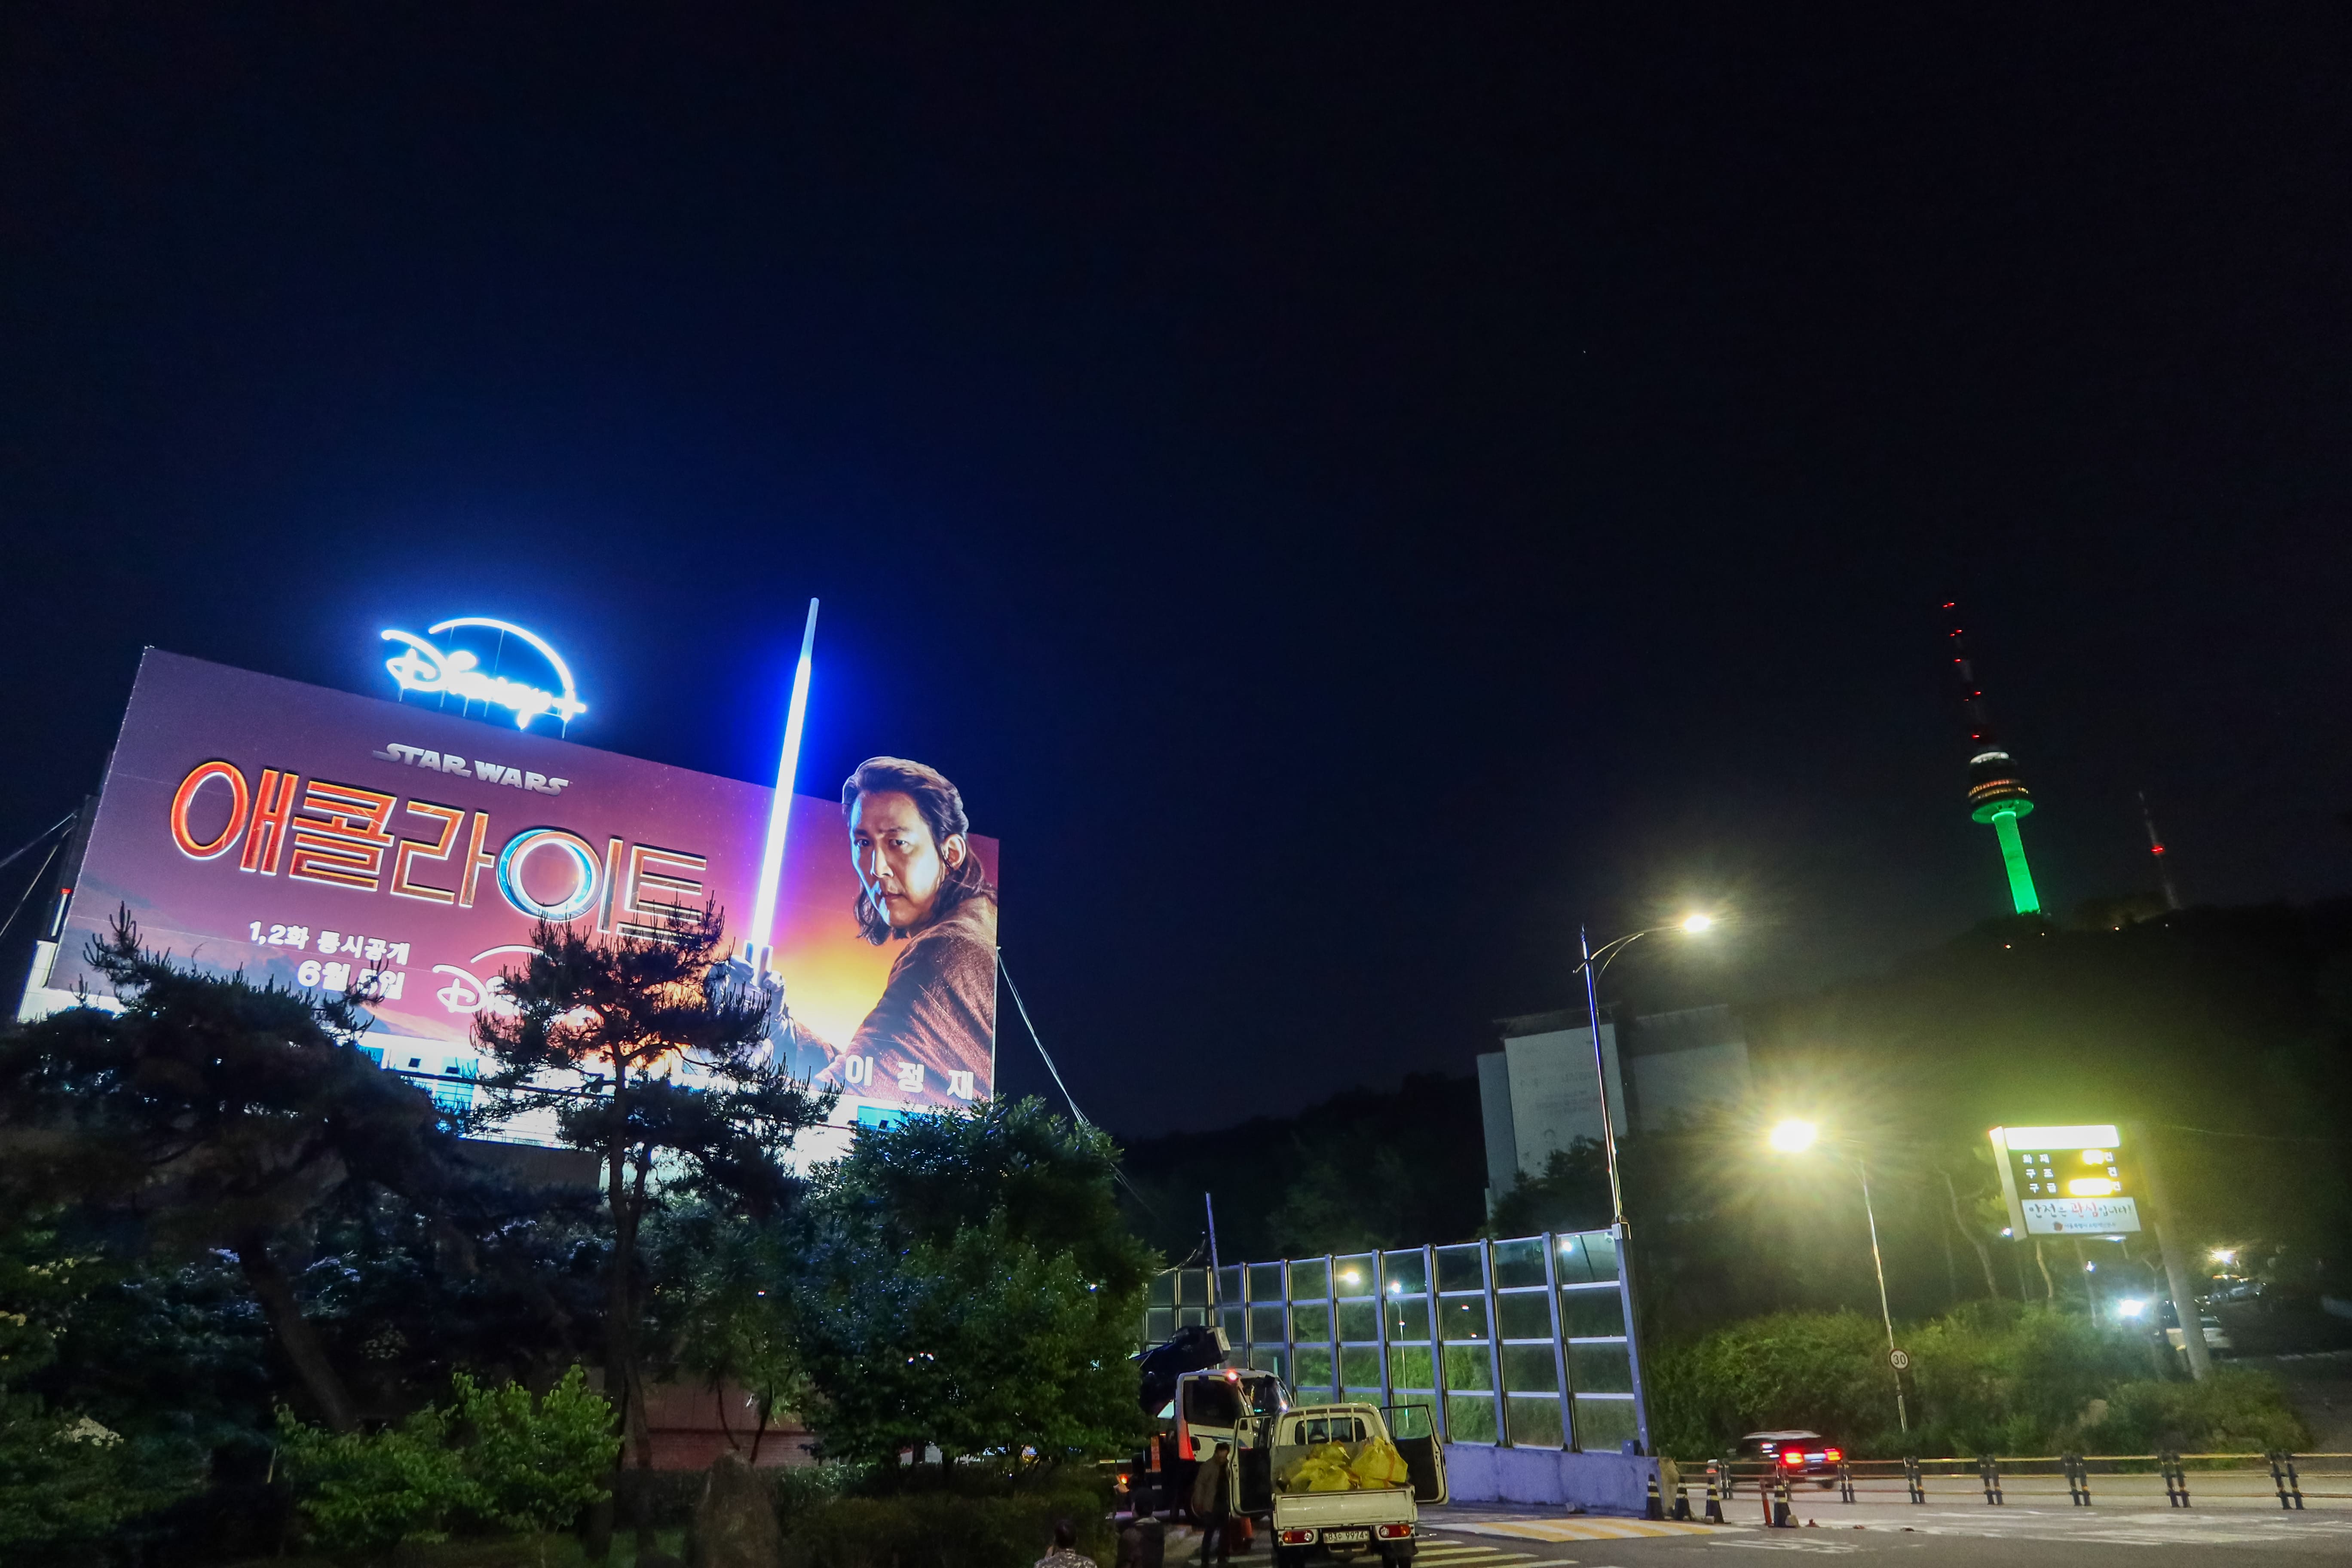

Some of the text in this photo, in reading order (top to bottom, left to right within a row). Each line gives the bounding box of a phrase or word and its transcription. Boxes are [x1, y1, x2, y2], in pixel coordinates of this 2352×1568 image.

[381, 617, 586, 729] Disney+
[372, 743, 569, 796] STAR WARS
[171, 761, 707, 948] 애콜라이트
[250, 921, 410, 965] 1,2화 동시공개
[298, 960, 405, 1000] 6월 5일
[2029, 1203, 2067, 1219] 안전은
[1893, 1354, 1906, 1365] 30
